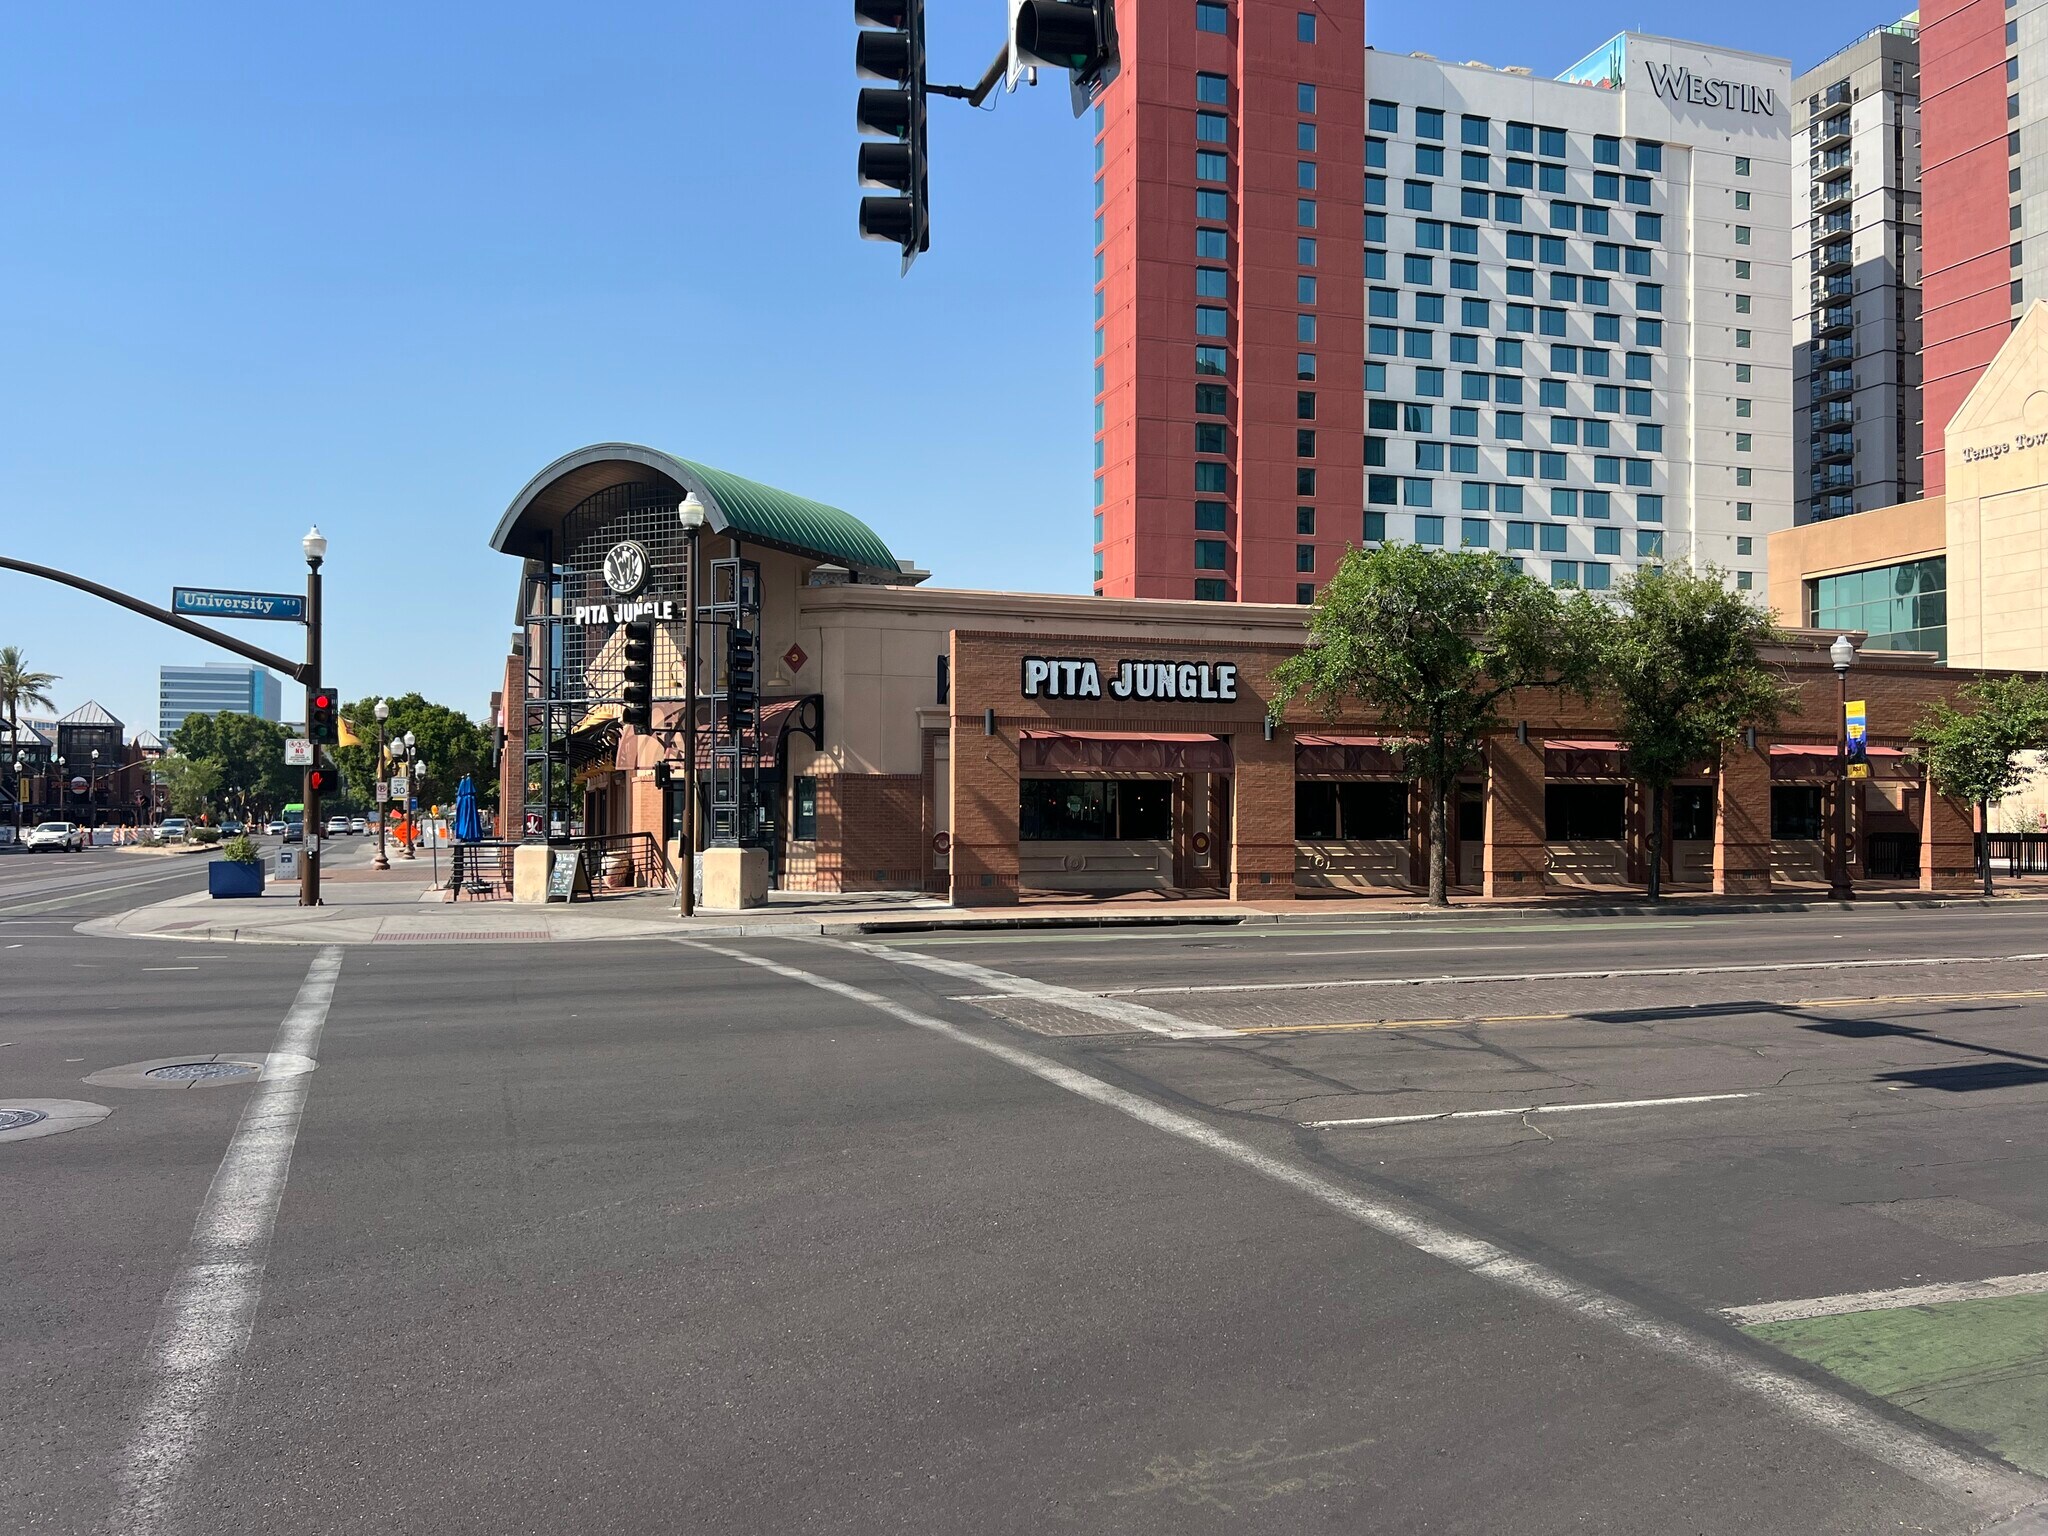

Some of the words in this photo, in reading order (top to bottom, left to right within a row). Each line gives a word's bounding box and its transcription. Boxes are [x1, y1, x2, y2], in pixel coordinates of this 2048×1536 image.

[1645, 61, 1774, 116] WESTIN
[1963, 443, 2010, 463] Tempe
[183, 593, 274, 613] University
[575, 604, 609, 625] PITA
[613, 601, 672, 623] JUNGLE
[1025, 660, 1101, 696] PITA
[1111, 662, 1238, 700] JUNGLE
